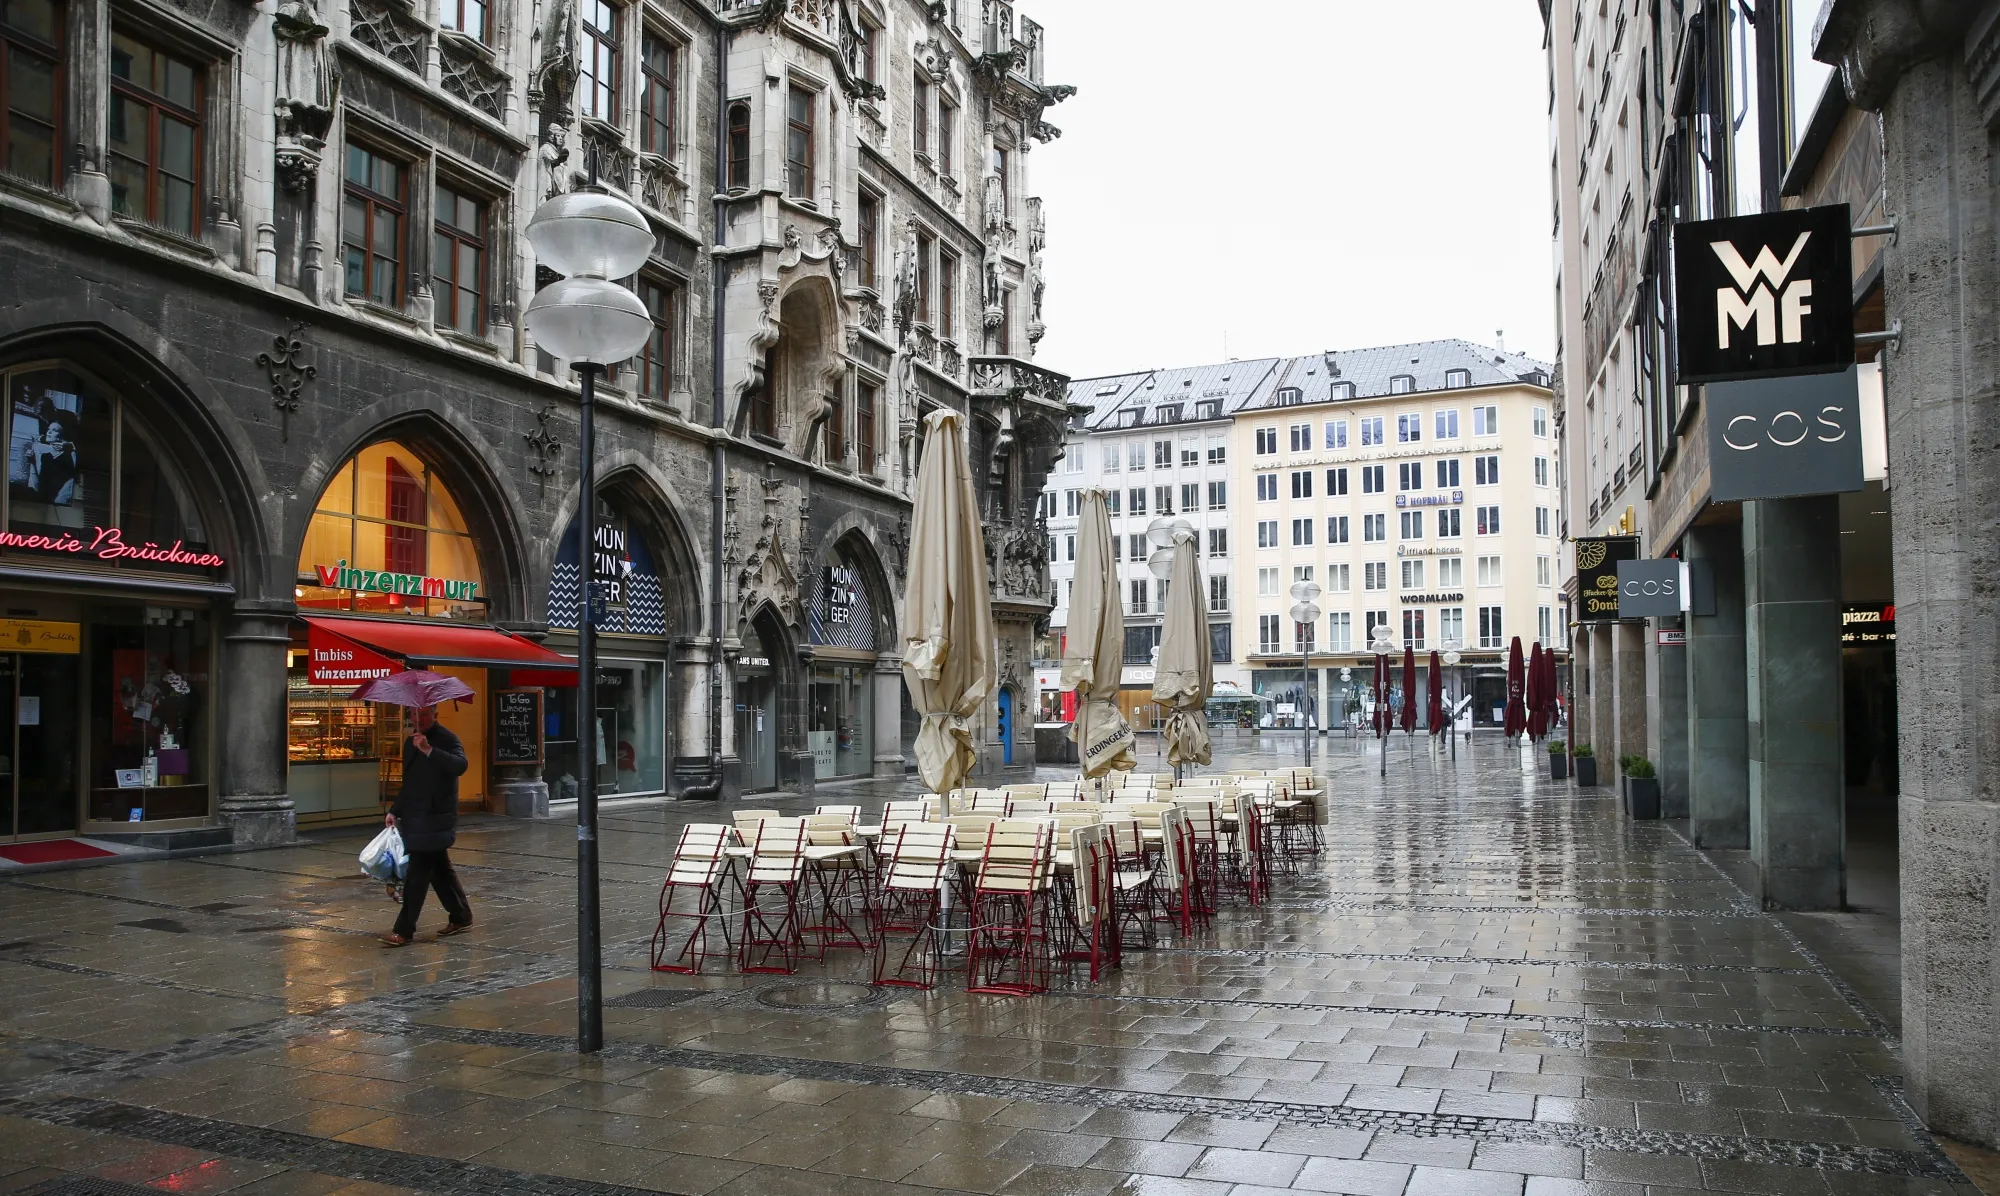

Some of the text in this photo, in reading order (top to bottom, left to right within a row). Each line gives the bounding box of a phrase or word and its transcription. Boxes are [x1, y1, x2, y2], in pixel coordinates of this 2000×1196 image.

[1709, 231, 1812, 349] WMF
[1723, 406, 1846, 450] COS
[1287, 454, 1370, 467] RESTAURANT
[1376, 444, 1470, 459] GLOCKENSPIEL
[1410, 495, 1448, 505] HOFBRÄU
[89, 526, 224, 566] Brückner
[314, 559, 479, 601] vinzenzmurr
[831, 565, 851, 586] MÜN
[831, 586, 847, 604] ZIN
[1623, 579, 1675, 597] COS
[1400, 593, 1464, 604] WORMLAND
[1588, 598, 1620, 612] Doni
[831, 606, 849, 624] GER
[1842, 607, 1880, 626] piazza
[314, 648, 353, 662] Imbiss
[736, 656, 750, 665] ANS
[314, 665, 391, 680] vinzenzmurr
[1129, 670, 1156, 680] IQO
[1085, 729, 1125, 758] ERDINGER
